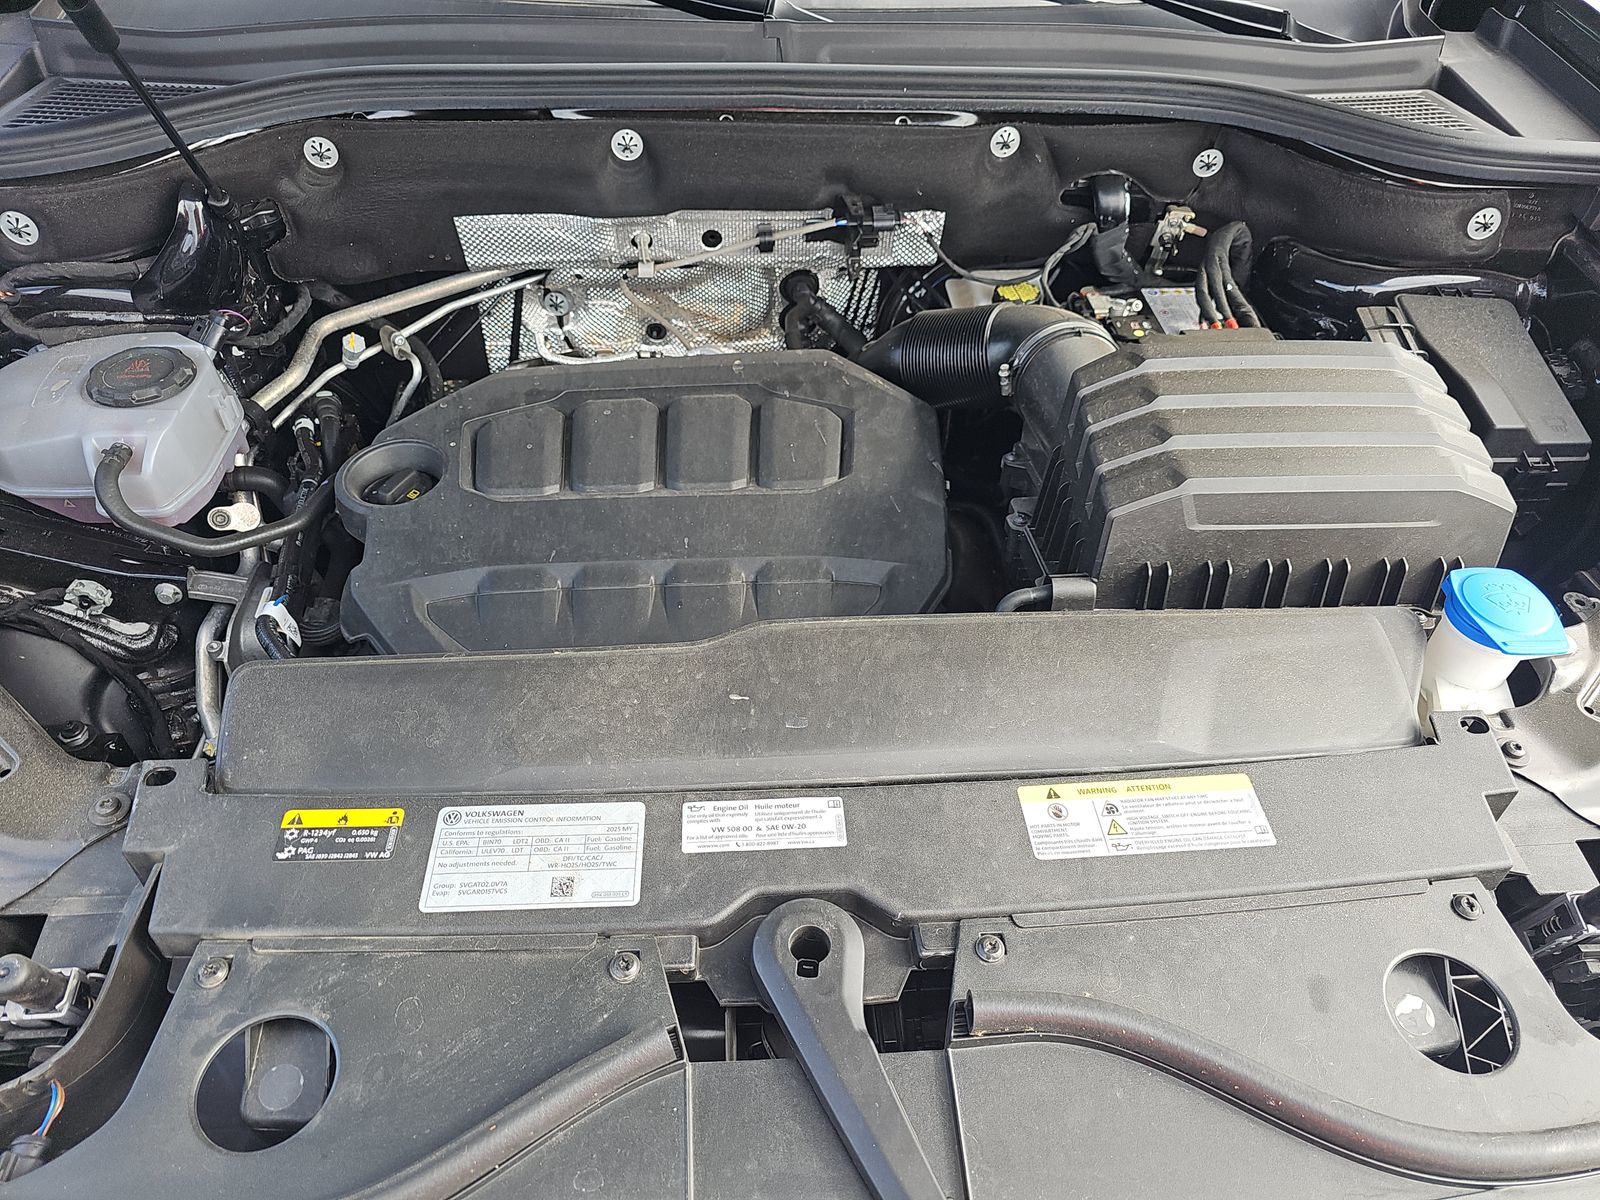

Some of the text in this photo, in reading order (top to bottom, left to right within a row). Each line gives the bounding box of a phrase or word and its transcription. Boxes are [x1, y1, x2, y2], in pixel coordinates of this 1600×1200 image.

[1077, 784, 1171, 795] WARNING ATTENTION
[303, 829, 337, 838] R-1234yf
[448, 861, 490, 869] adjustments
